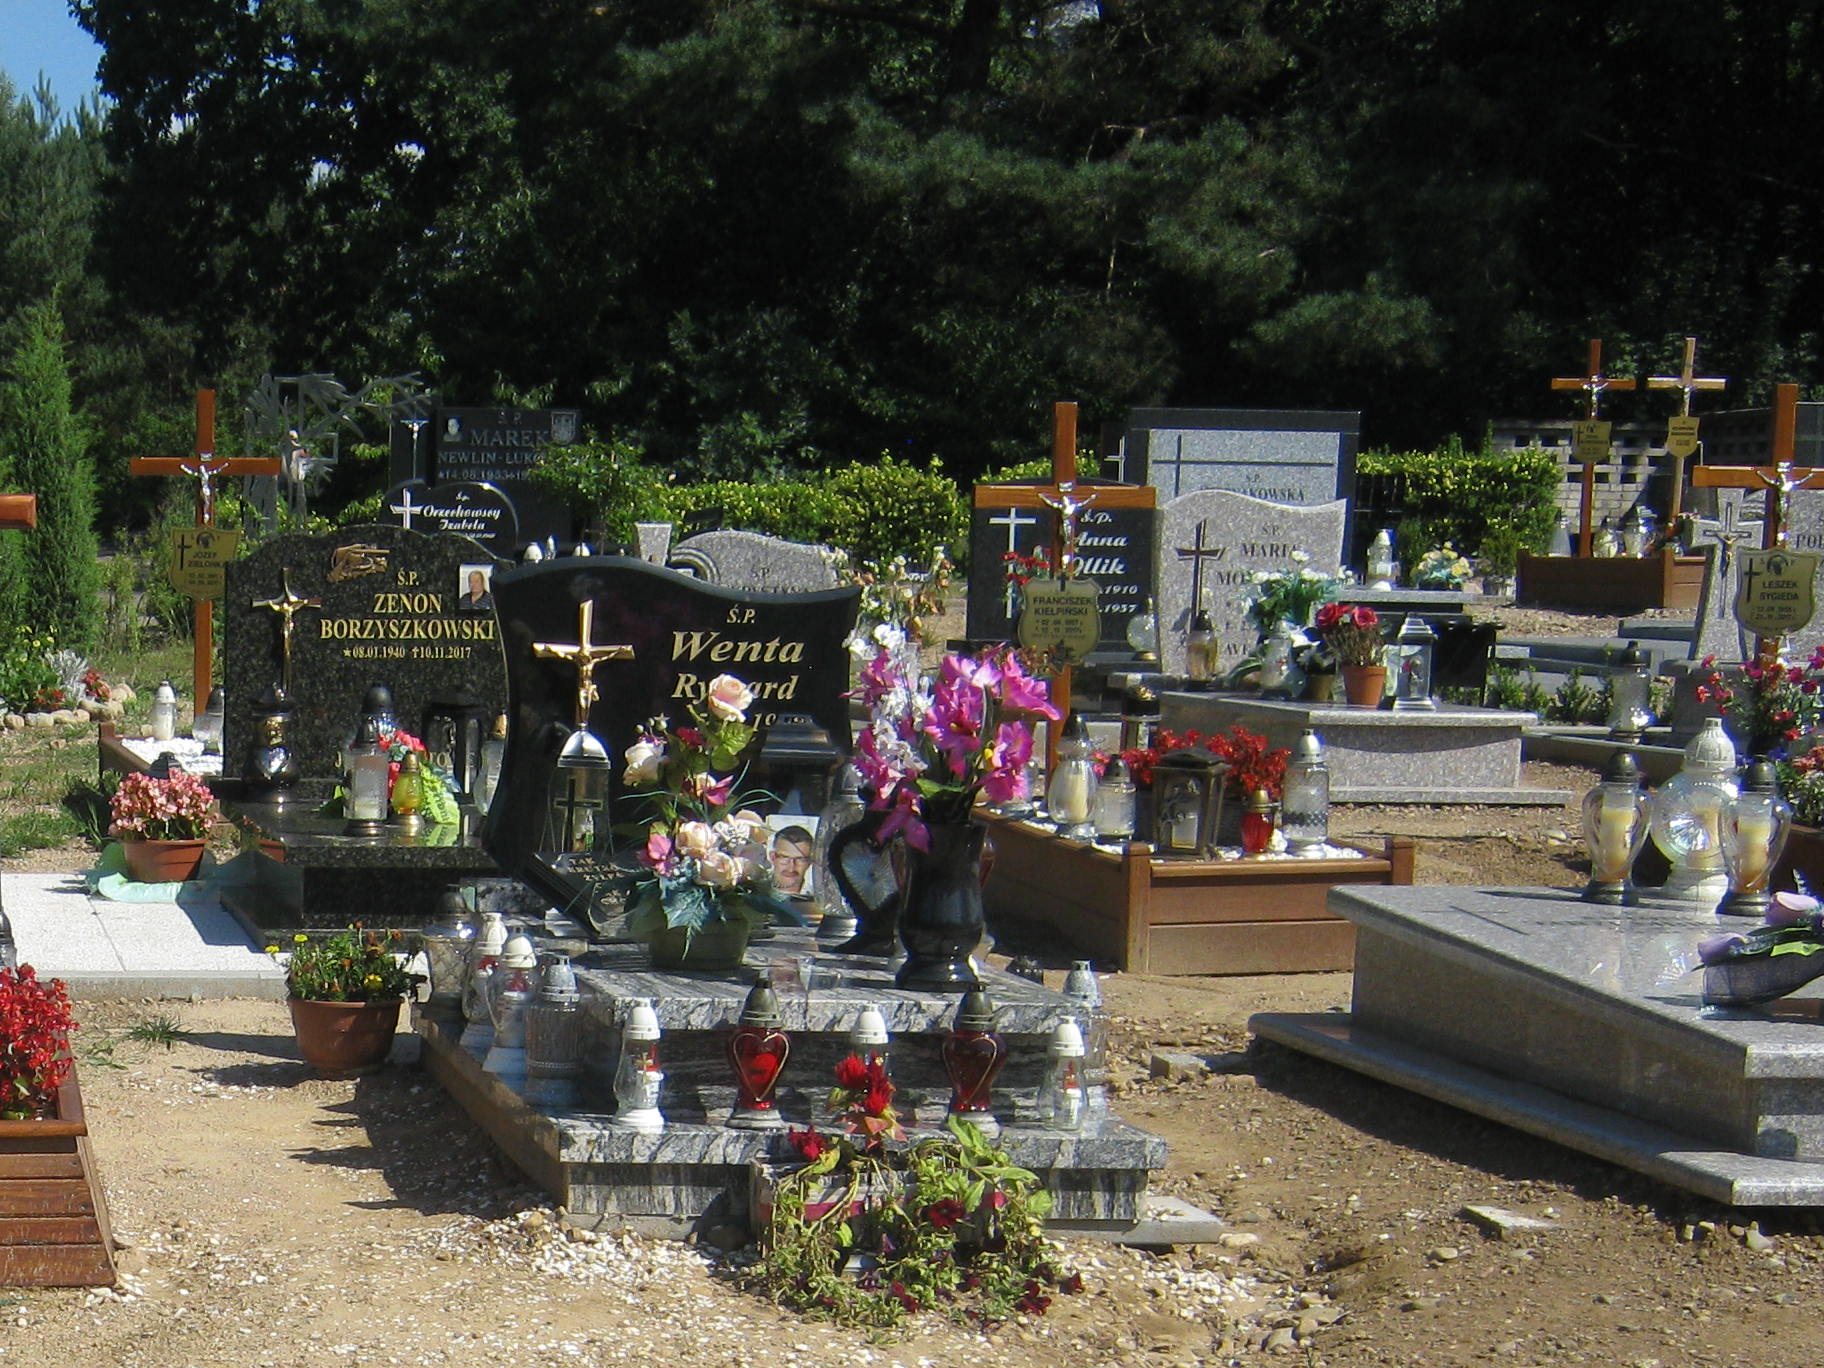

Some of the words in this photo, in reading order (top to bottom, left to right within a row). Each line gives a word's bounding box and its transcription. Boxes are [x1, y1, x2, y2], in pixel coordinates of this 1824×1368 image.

[1074, 531, 1127, 547] Anna
[373, 593, 442, 614] ZENON
[726, 604, 756, 624] Ś.P.
[320, 619, 495, 640] BORZYSZKOWSKI
[671, 631, 805, 663] Wenta
